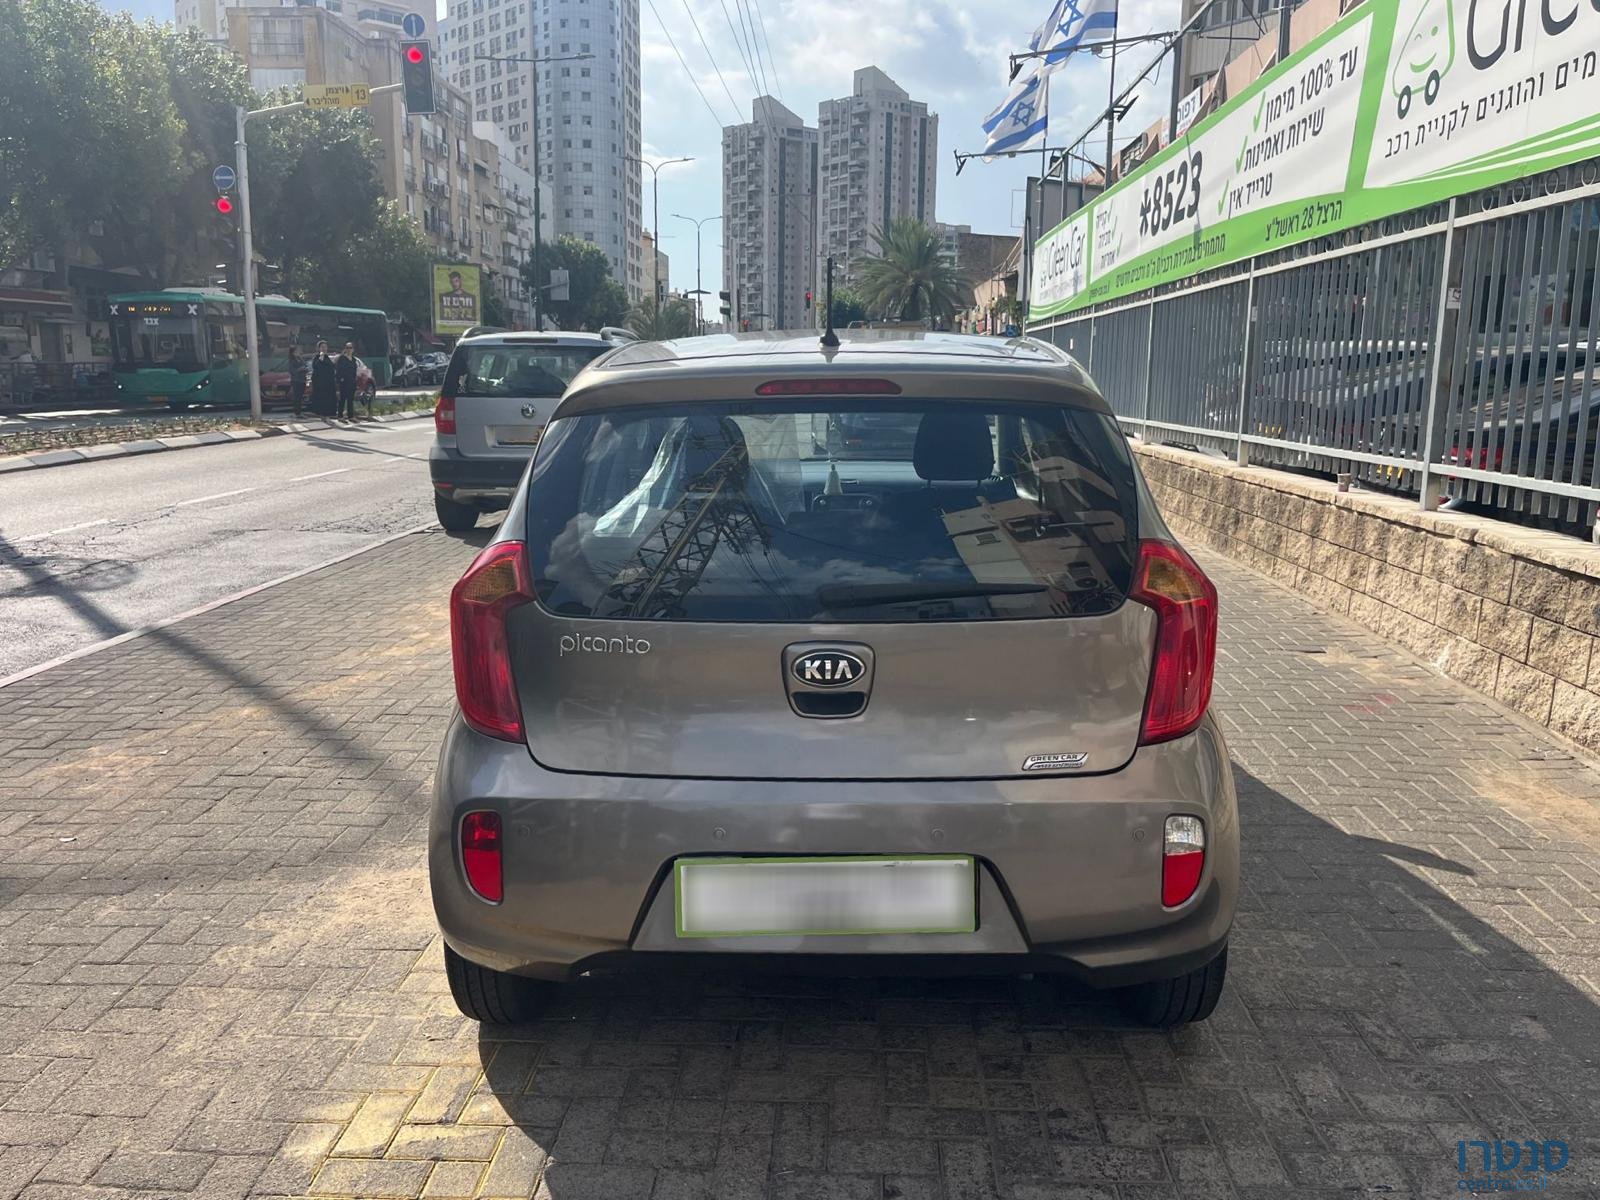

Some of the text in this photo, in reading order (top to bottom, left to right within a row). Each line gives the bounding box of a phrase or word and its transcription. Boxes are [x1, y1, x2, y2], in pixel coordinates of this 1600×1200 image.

[355, 89, 366, 100] 13
[1264, 45, 1358, 133] עד 100% מימון
[1475, 72, 1545, 122] והוגנים
[1414, 101, 1470, 146] לקניית
[1243, 106, 1325, 173] שירות ואמינות
[1384, 130, 1410, 159] רכב
[1227, 171, 1273, 220] טרייד אין
[1300, 206, 1314, 231] 28
[1316, 199, 1343, 225] הרצל
[559, 633, 651, 657] picanto
[804, 659, 854, 680] KIA
